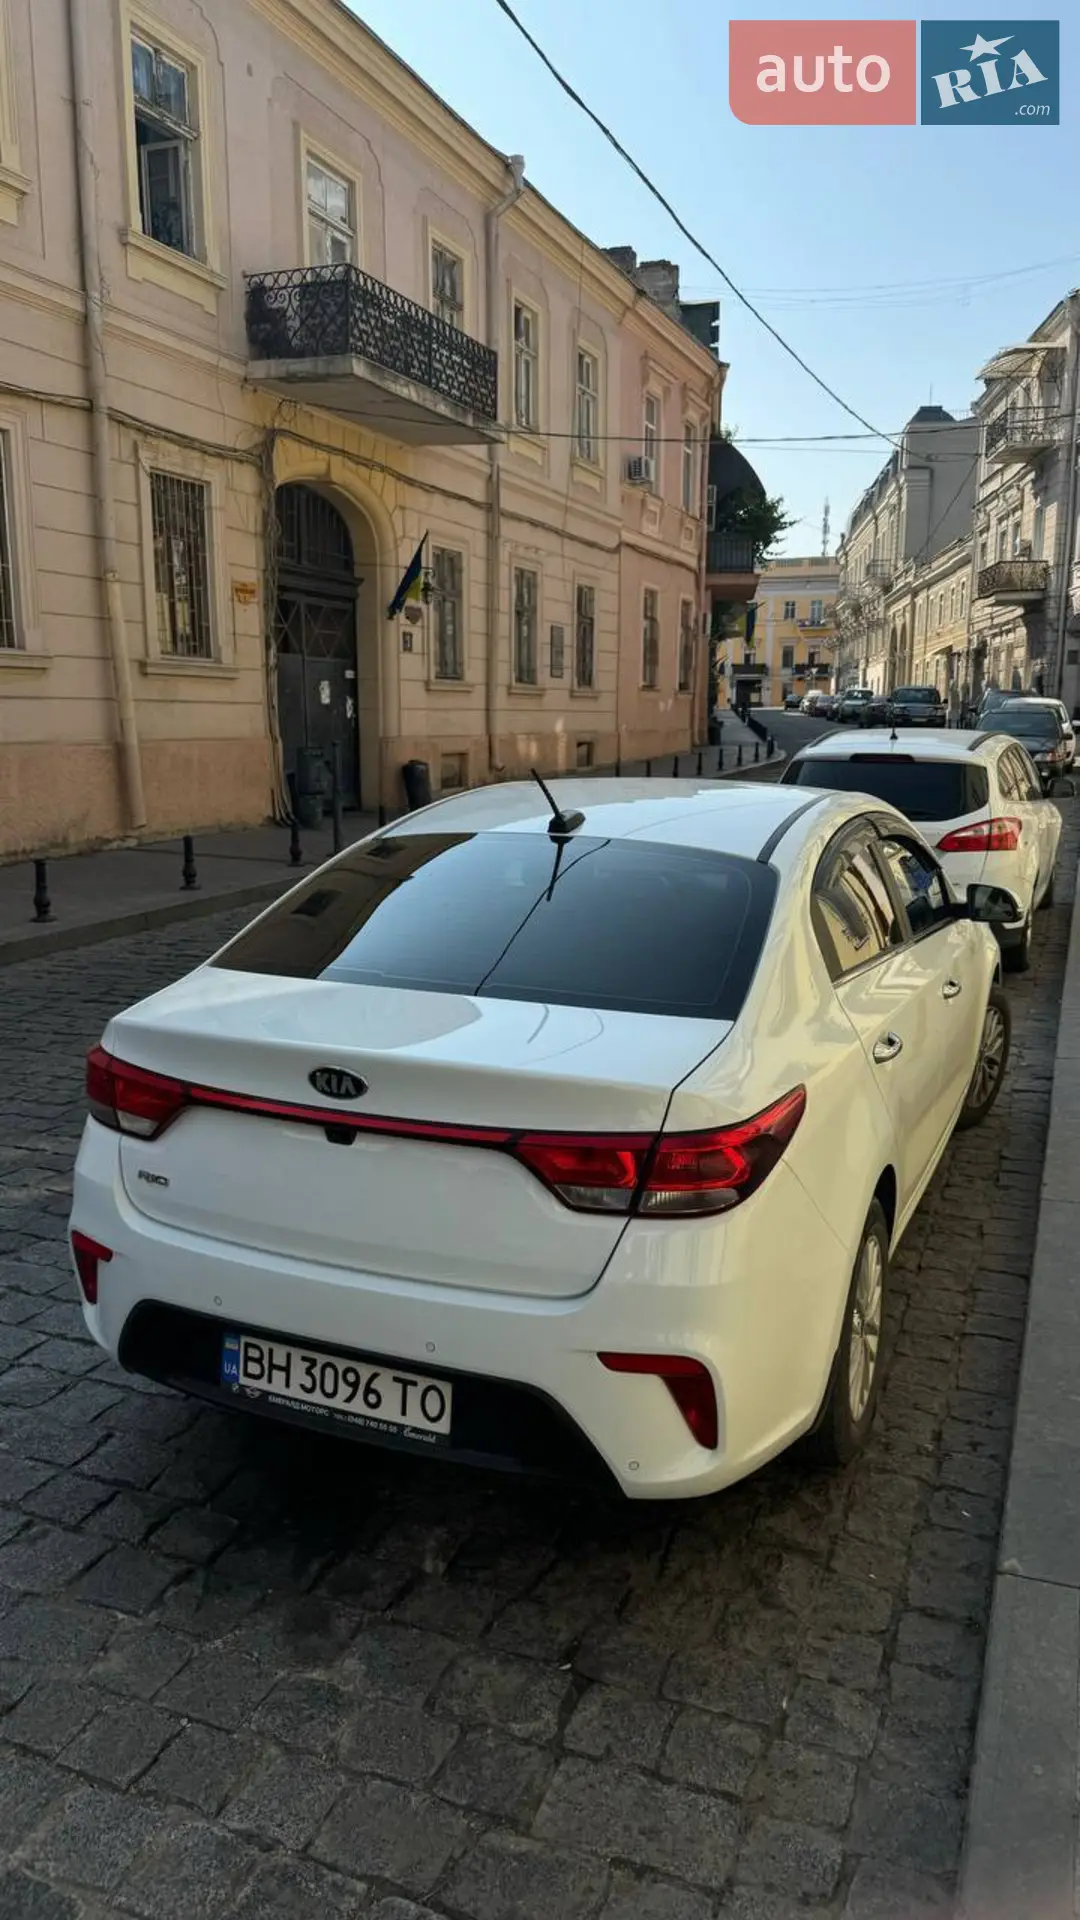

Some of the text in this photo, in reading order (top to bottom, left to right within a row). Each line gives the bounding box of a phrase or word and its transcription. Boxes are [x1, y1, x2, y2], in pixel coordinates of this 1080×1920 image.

[315, 1071, 357, 1096] KIA
[138, 1169, 169, 1188] RIO
[224, 1360, 238, 1376] UA
[300, 1355, 382, 1410] 3096
[392, 1375, 446, 1423] TO
